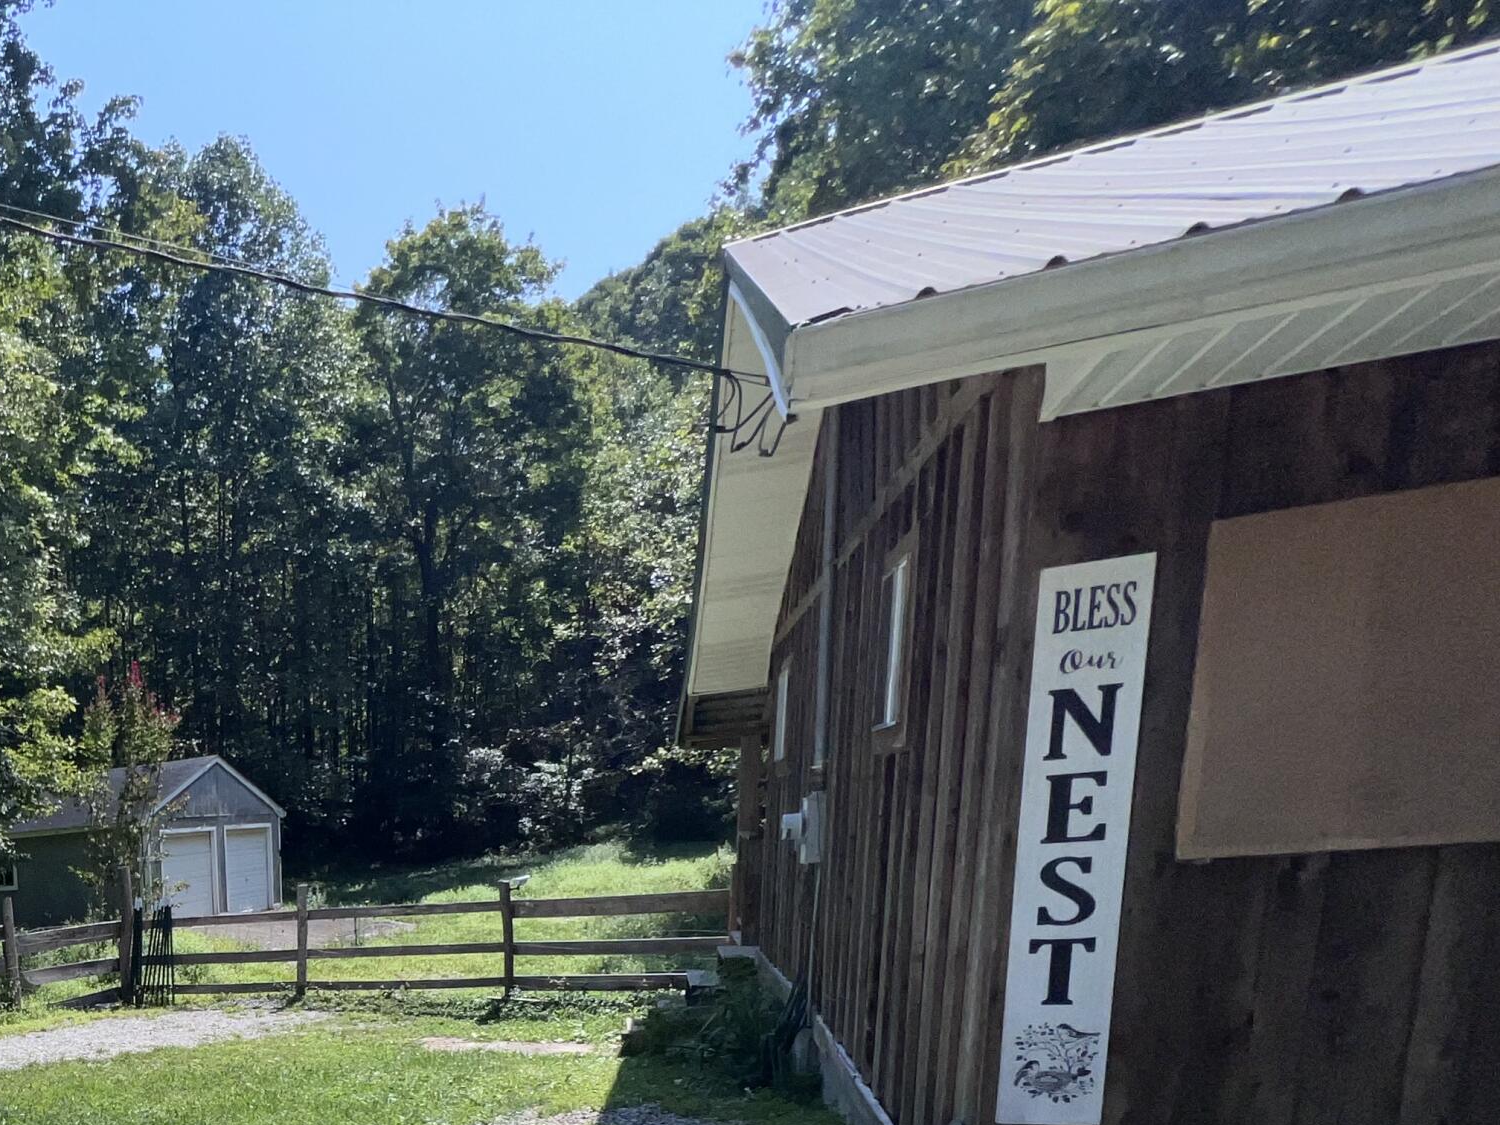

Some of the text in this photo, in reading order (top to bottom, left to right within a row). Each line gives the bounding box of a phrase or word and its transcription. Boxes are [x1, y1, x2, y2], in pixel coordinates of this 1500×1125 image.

[1052, 581, 1137, 634] BLESS
[1059, 649, 1123, 675] Our
[1028, 682, 1124, 1005] NEST
